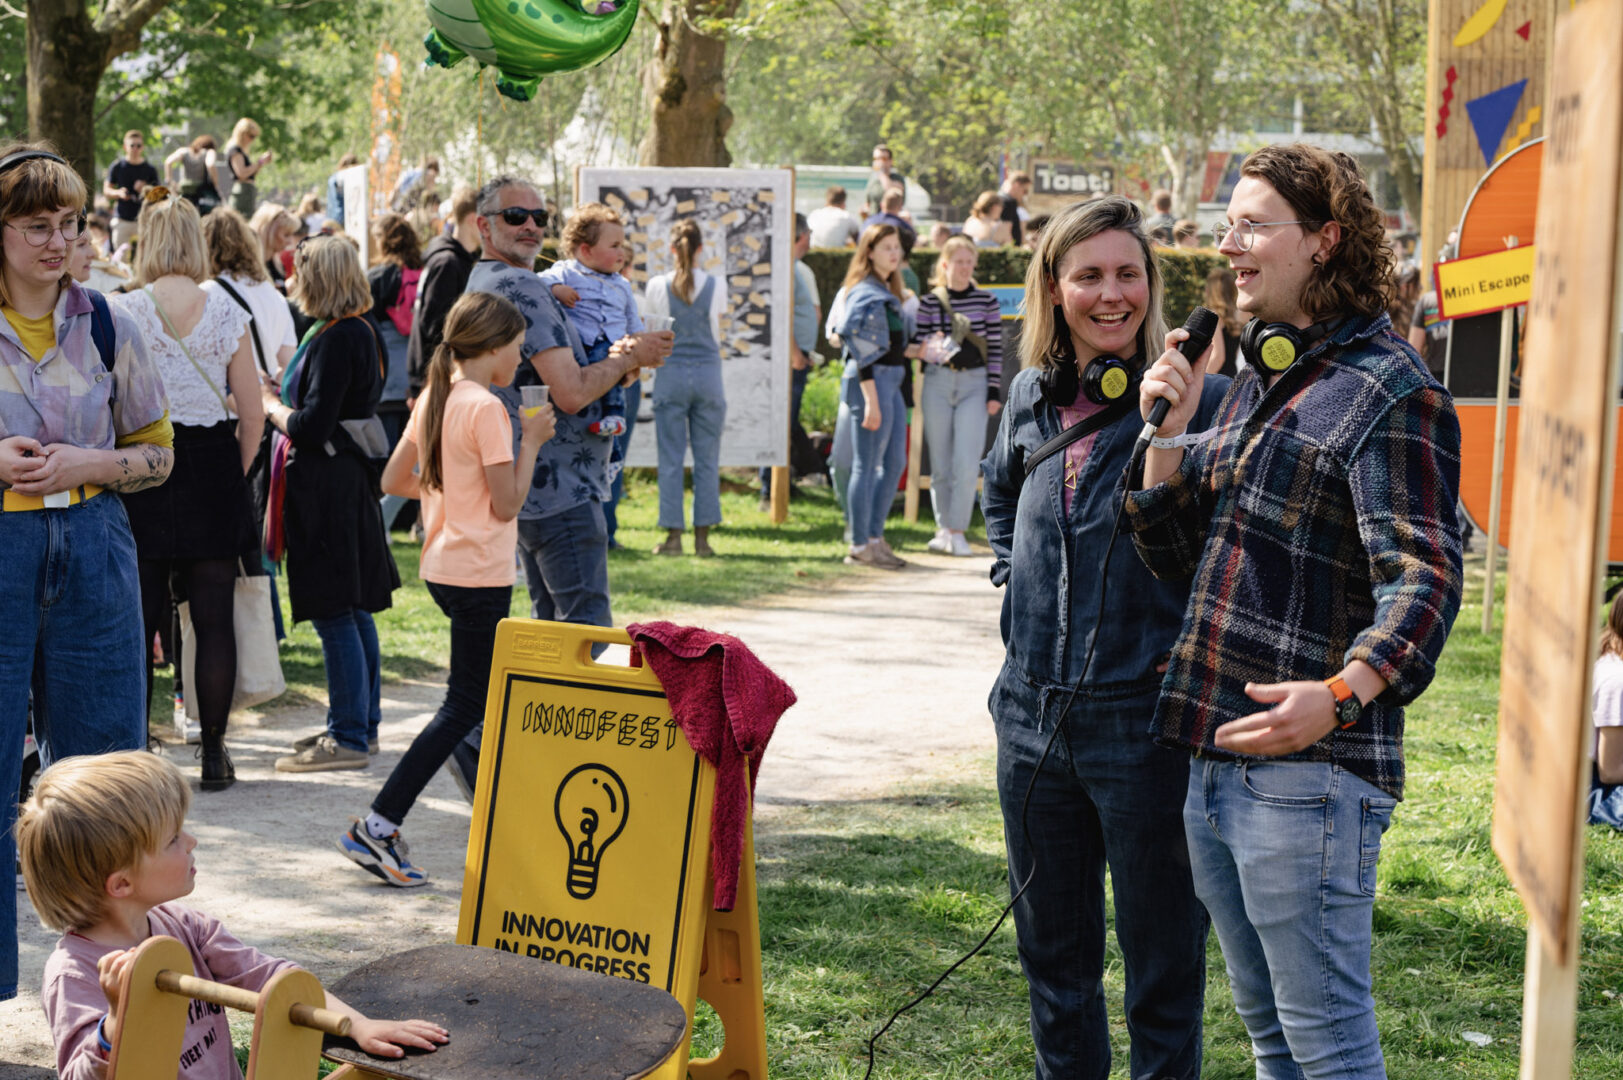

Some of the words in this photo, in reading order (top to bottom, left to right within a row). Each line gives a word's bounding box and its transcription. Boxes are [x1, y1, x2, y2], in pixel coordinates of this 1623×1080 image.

[1036, 168, 1110, 192] Tosti
[1444, 283, 1475, 300] Mini
[1479, 273, 1530, 293] Escape
[522, 701, 678, 751] INNOFEST
[502, 910, 651, 957] INNOVATION
[526, 944, 651, 985] PROGRESS
